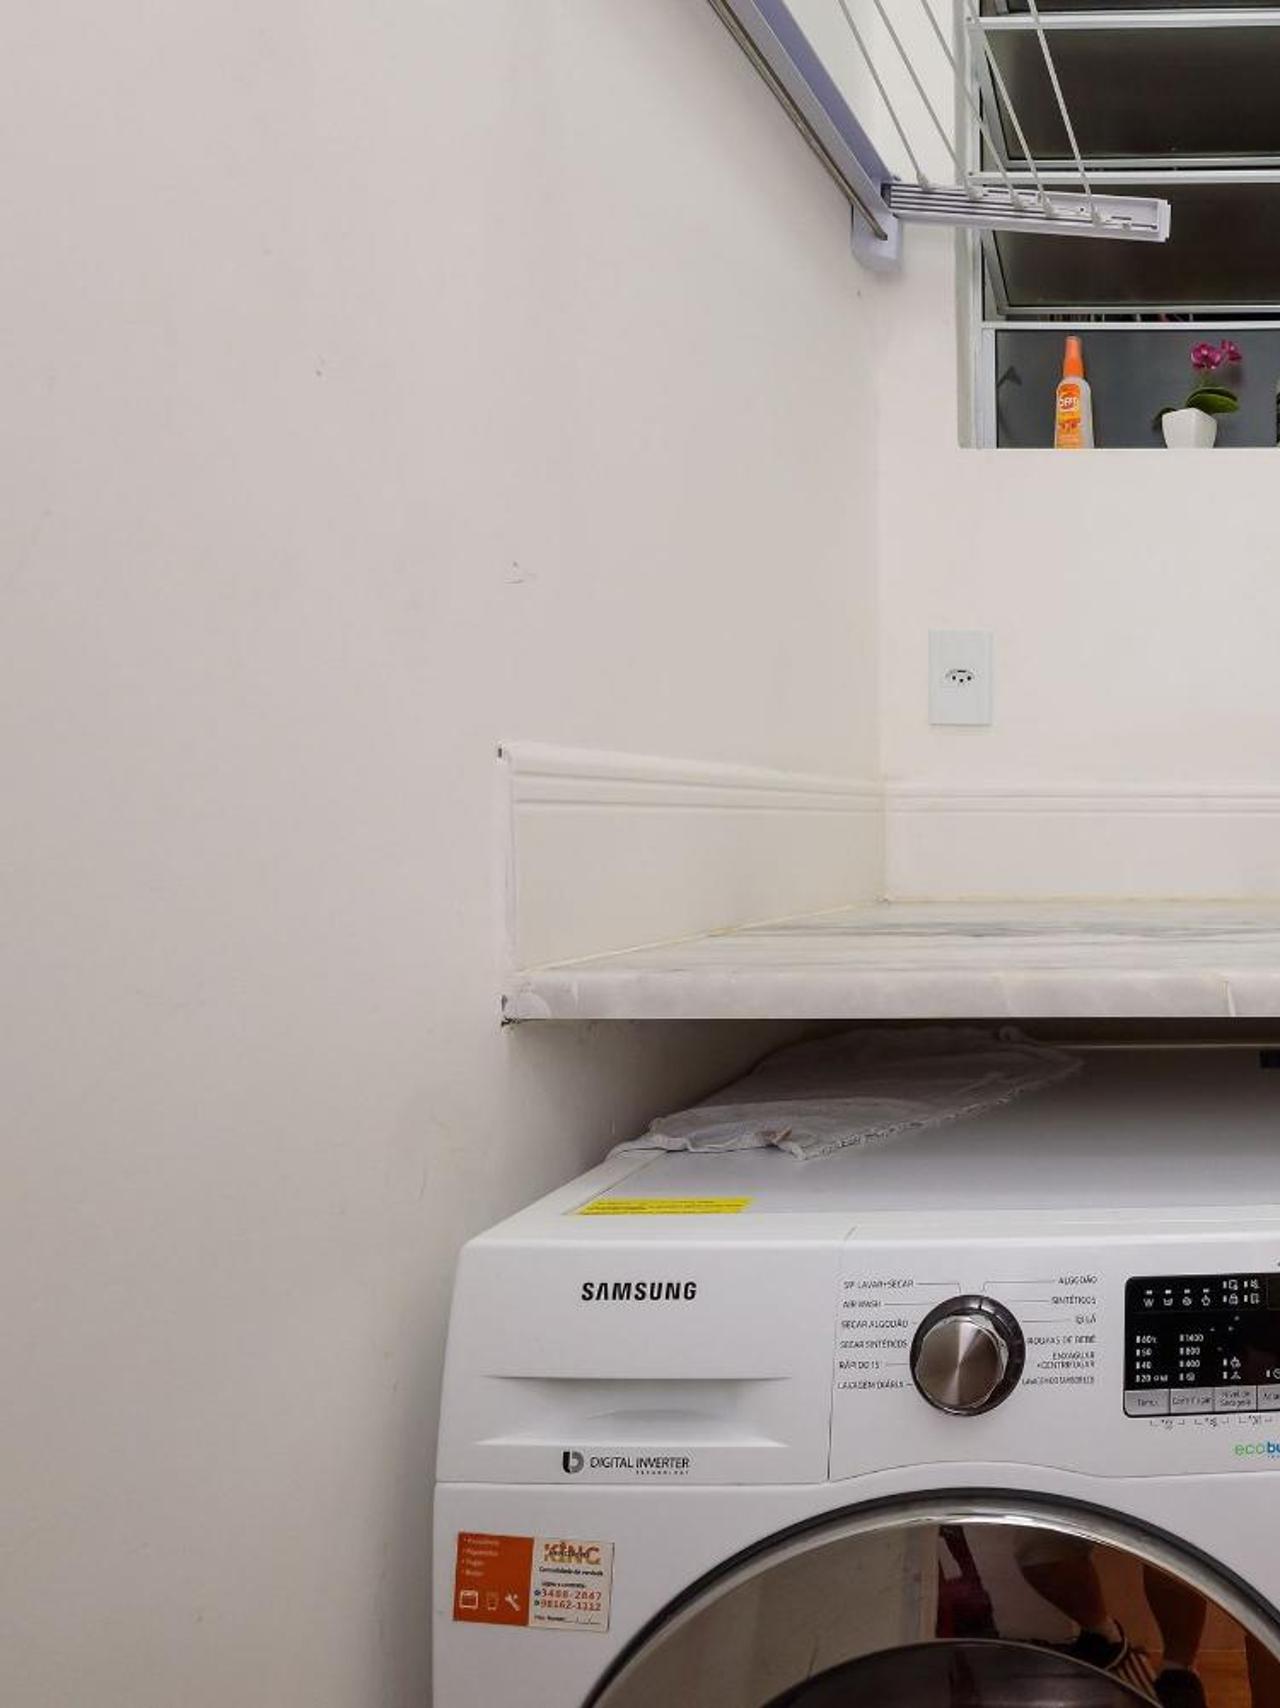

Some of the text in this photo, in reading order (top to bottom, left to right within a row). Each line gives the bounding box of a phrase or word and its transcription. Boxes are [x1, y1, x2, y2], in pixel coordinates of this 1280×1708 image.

[581, 1281, 698, 1302] SAMSUNG
[589, 1456, 690, 1469] DIGITAL INVERTER
